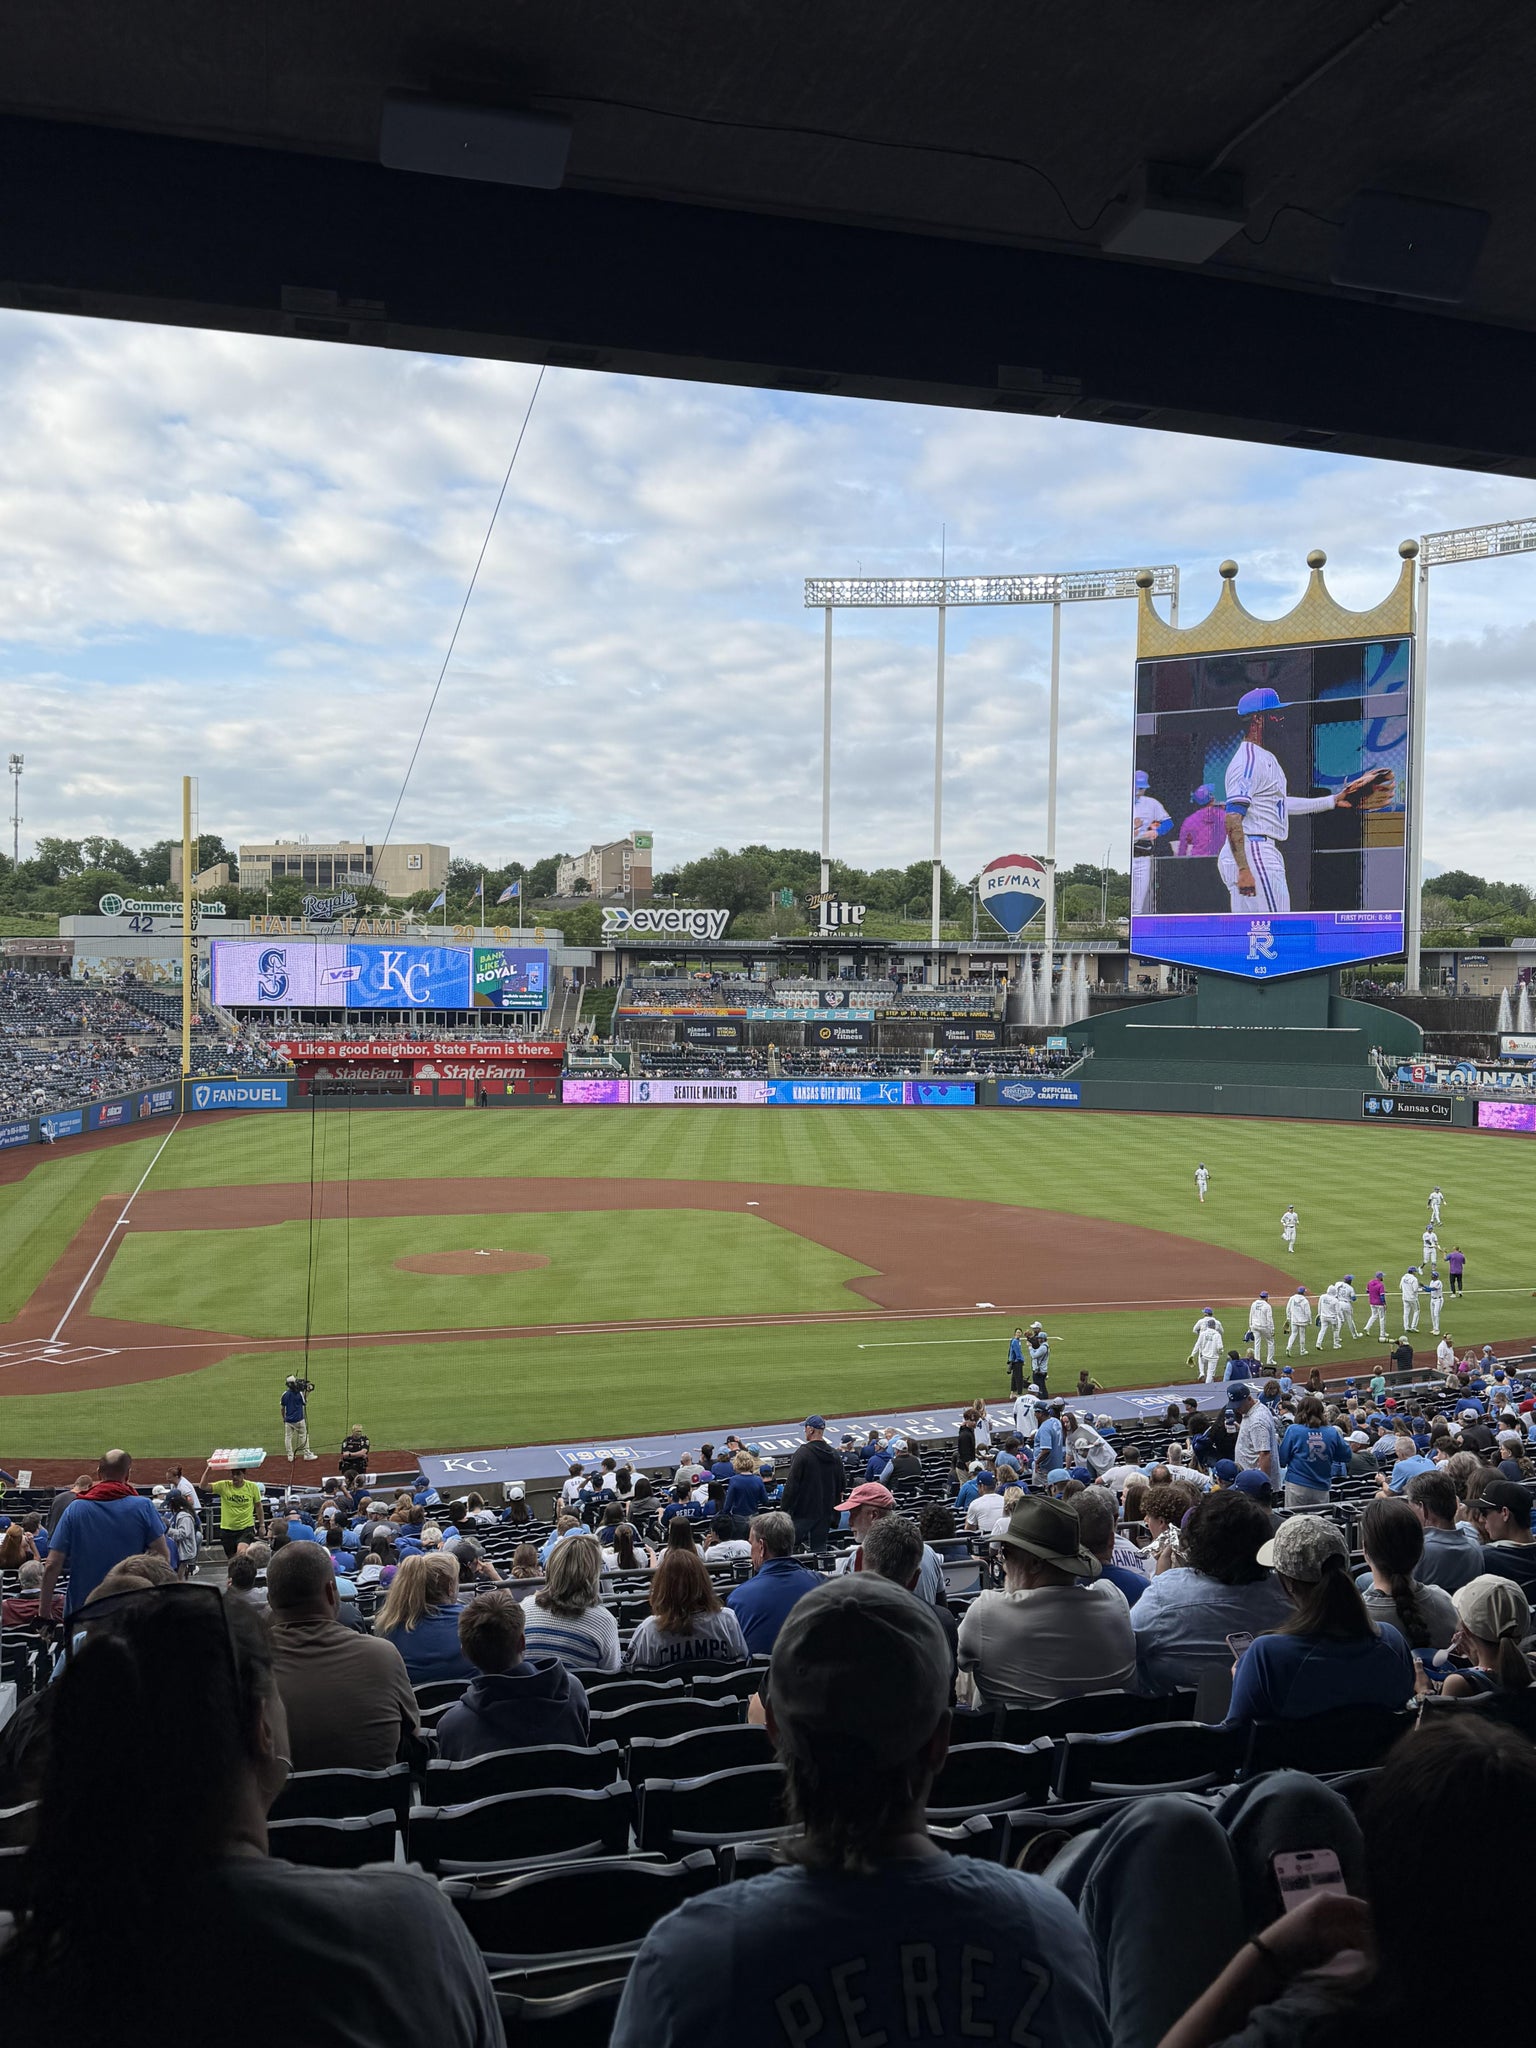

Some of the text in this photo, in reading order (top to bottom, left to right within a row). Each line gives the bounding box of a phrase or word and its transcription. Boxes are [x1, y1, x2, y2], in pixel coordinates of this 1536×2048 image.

[988, 875, 1040, 889] RE/MAX
[125, 900, 184, 913] Commerc
[302, 889, 358, 918] Royals
[805, 892, 837, 909] Miller
[817, 901, 866, 931] Lite
[129, 916, 154, 933] 42
[250, 915, 316, 935] HALL
[342, 918, 408, 938] FAME
[633, 911, 726, 938] evergy
[453, 925, 545, 944] 20 10 5
[480, 951, 504, 963] BANK
[480, 961, 499, 972] LIKE
[378, 951, 430, 1003] KC
[476, 966, 517, 984] ROYAL
[833, 1027, 858, 1036] planet
[298, 1043, 553, 1058] Like a good neighbor, State Farm is there.
[213, 1088, 282, 1102] FANDUEL
[673, 1085, 738, 1100] SEATTLE MARINERS
[792, 1086, 861, 1101] KANSAS CITY ROYALS
[879, 1083, 898, 1104] KC
[1041, 1086, 1072, 1094] OFFICIAL
[1398, 1103, 1450, 1116] Kansas City
[1023, 1404, 1032, 1417] 7
[566, 1448, 631, 1462] 1985
[440, 1458, 492, 1473] KC
[660, 1639, 728, 1664] CHAMPS
[773, 1940, 1053, 2048] PEREZ
